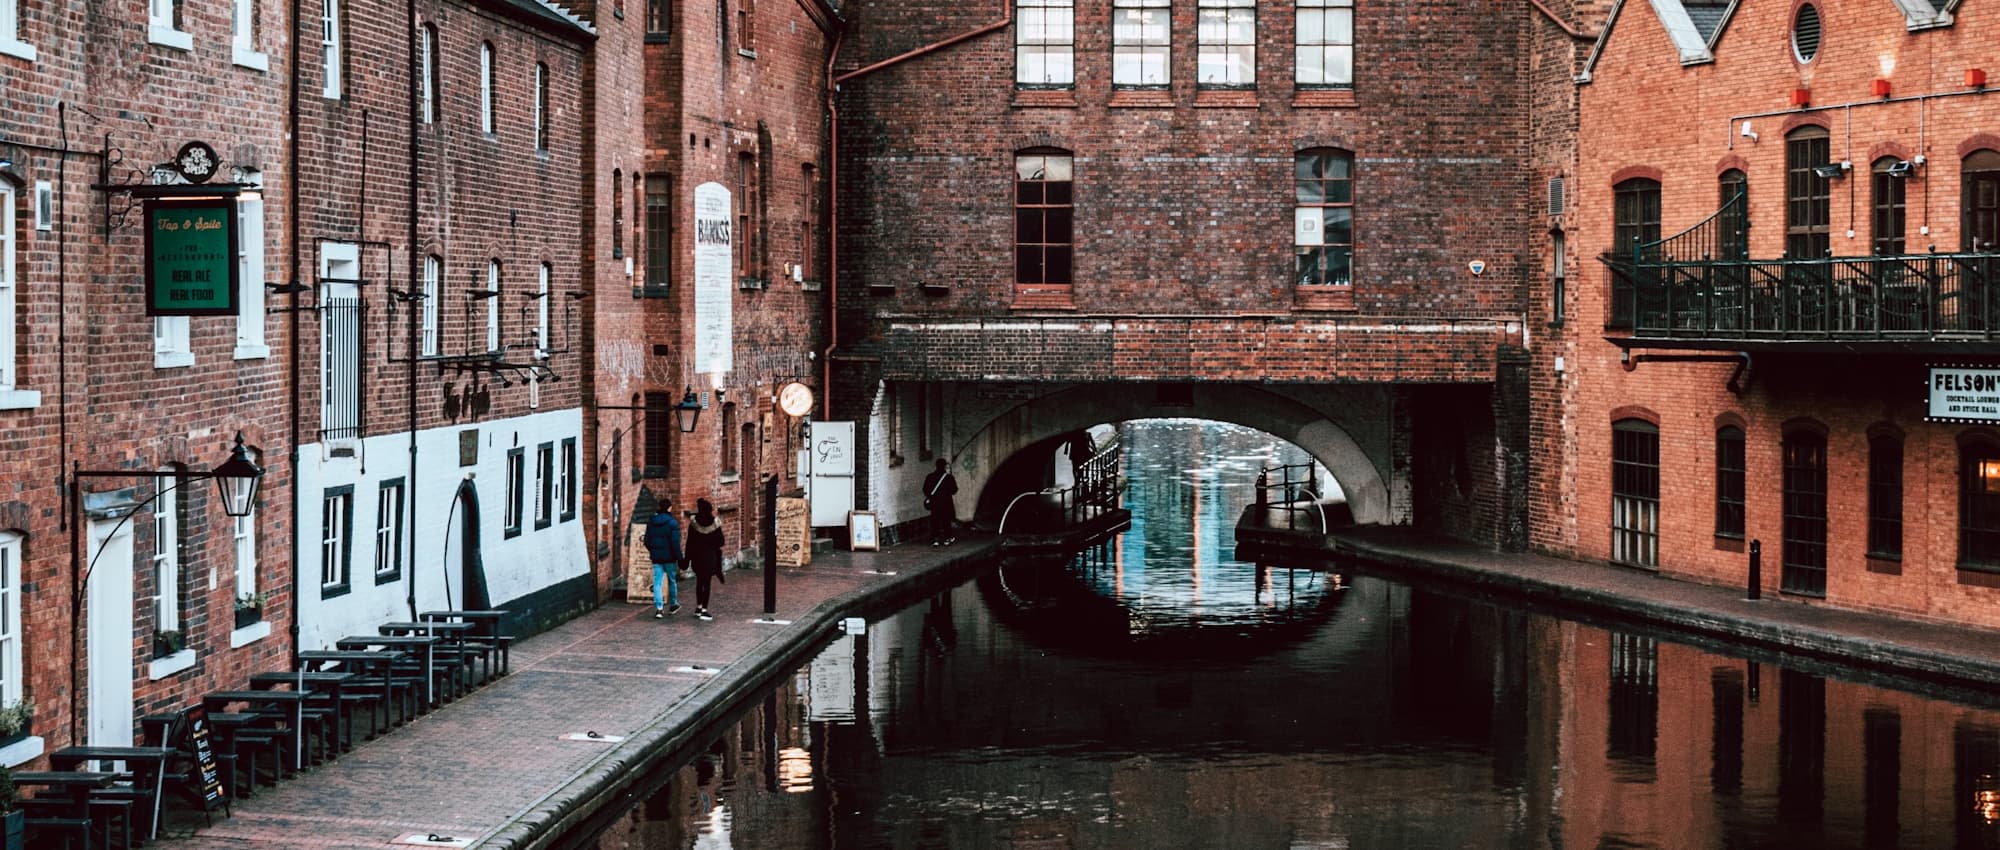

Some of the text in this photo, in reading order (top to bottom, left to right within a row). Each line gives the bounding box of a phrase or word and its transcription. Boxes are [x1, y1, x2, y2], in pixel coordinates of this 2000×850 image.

[158, 218, 179, 232] Tap
[194, 216, 223, 232] Spile
[171, 269, 212, 282] REAL ALE
[169, 288, 215, 301] REAL FOOD
[1935, 374, 2000, 392] FELSON'
[1946, 395, 1975, 403] COCKTAIL
[1962, 405, 1980, 413] STICK
